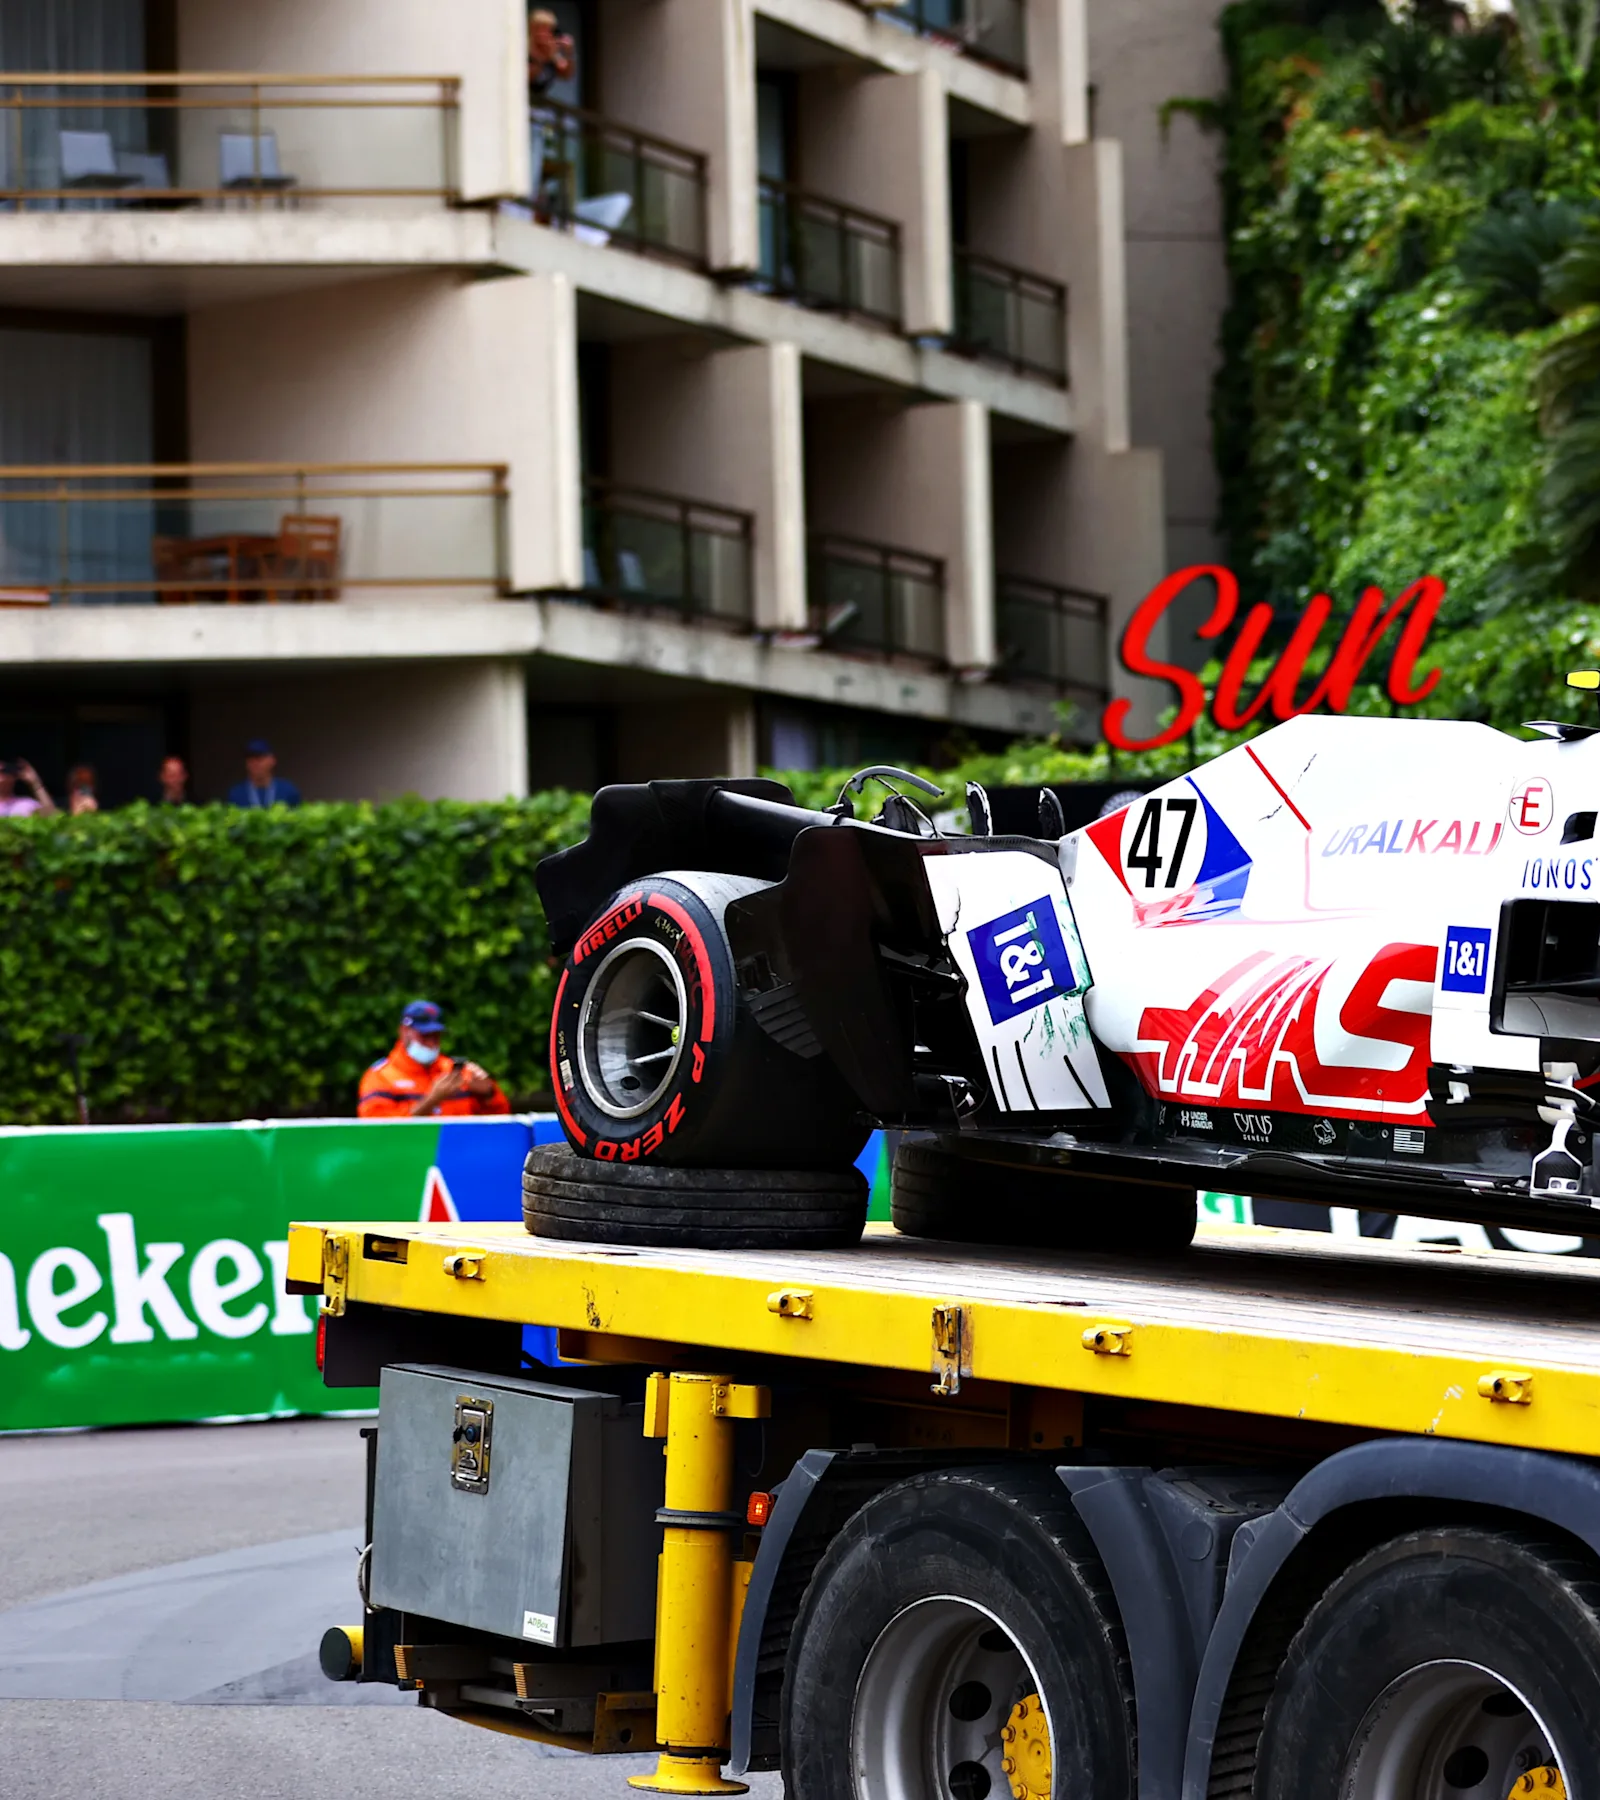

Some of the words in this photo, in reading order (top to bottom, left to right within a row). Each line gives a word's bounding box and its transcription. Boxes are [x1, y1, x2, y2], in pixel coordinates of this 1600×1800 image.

[1103, 564, 1446, 751] Sun
[1520, 787, 1543, 827] E
[1127, 798, 1197, 888] 47
[1321, 819, 1502, 857] URALKALI
[1522, 858, 1593, 890] IONOS
[573, 891, 644, 966] PIRELLI
[994, 911, 1054, 1004] 1&1
[1448, 940, 1486, 977] 1&1
[1137, 943, 1439, 1115] HAAS
[594, 1092, 687, 1163] ZERO
[1190, 1111, 1209, 1121] UNDER
[1191, 1120, 1213, 1131] ARMOUR
